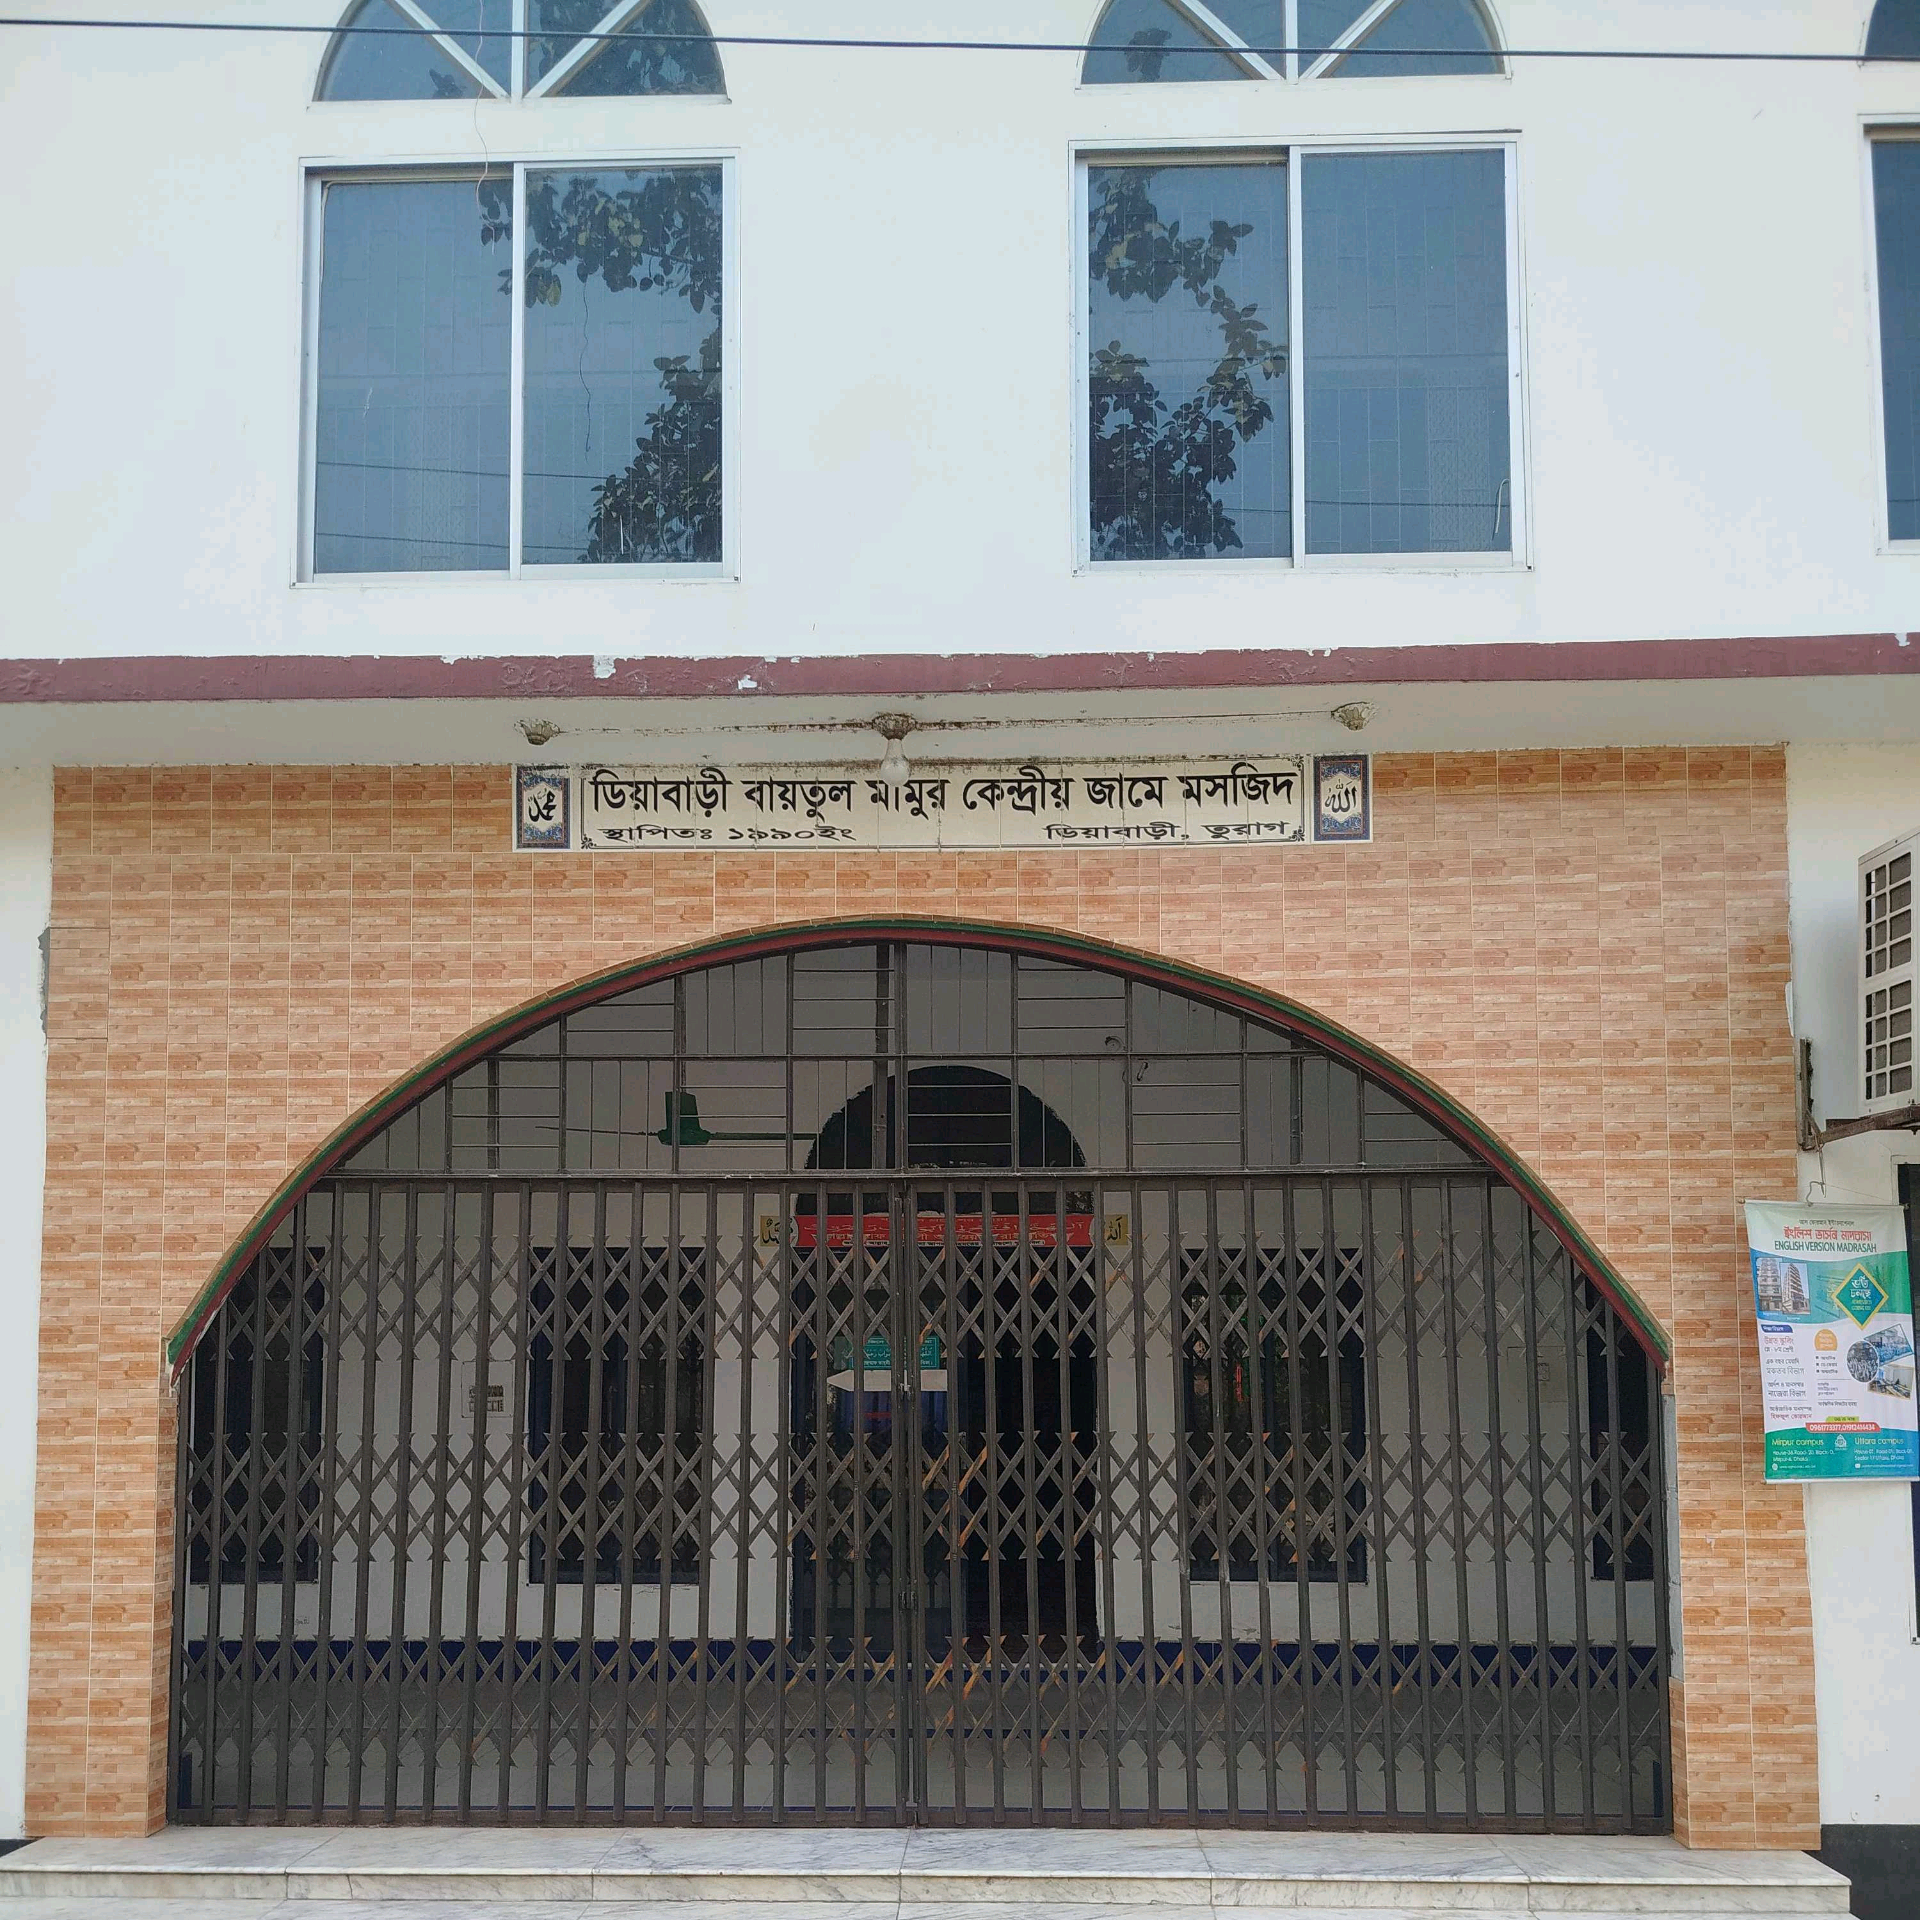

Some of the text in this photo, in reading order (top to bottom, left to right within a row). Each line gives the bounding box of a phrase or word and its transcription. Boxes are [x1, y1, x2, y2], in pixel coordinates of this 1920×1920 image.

[741, 776, 858, 823] বায়তুল
[963, 765, 1075, 816] কেন্দ্রীয়
[1082, 772, 1169, 809] জামে
[1176, 762, 1298, 807] মসজিদ
[1200, 820, 1290, 840] তুরাগ
[1783, 1225, 1813, 1240] ইংলিশ
[1774, 1240, 1877, 1253] ENGLISH VERSION MADRASAH
[1771, 1438, 1824, 1447] Mirpur campus
